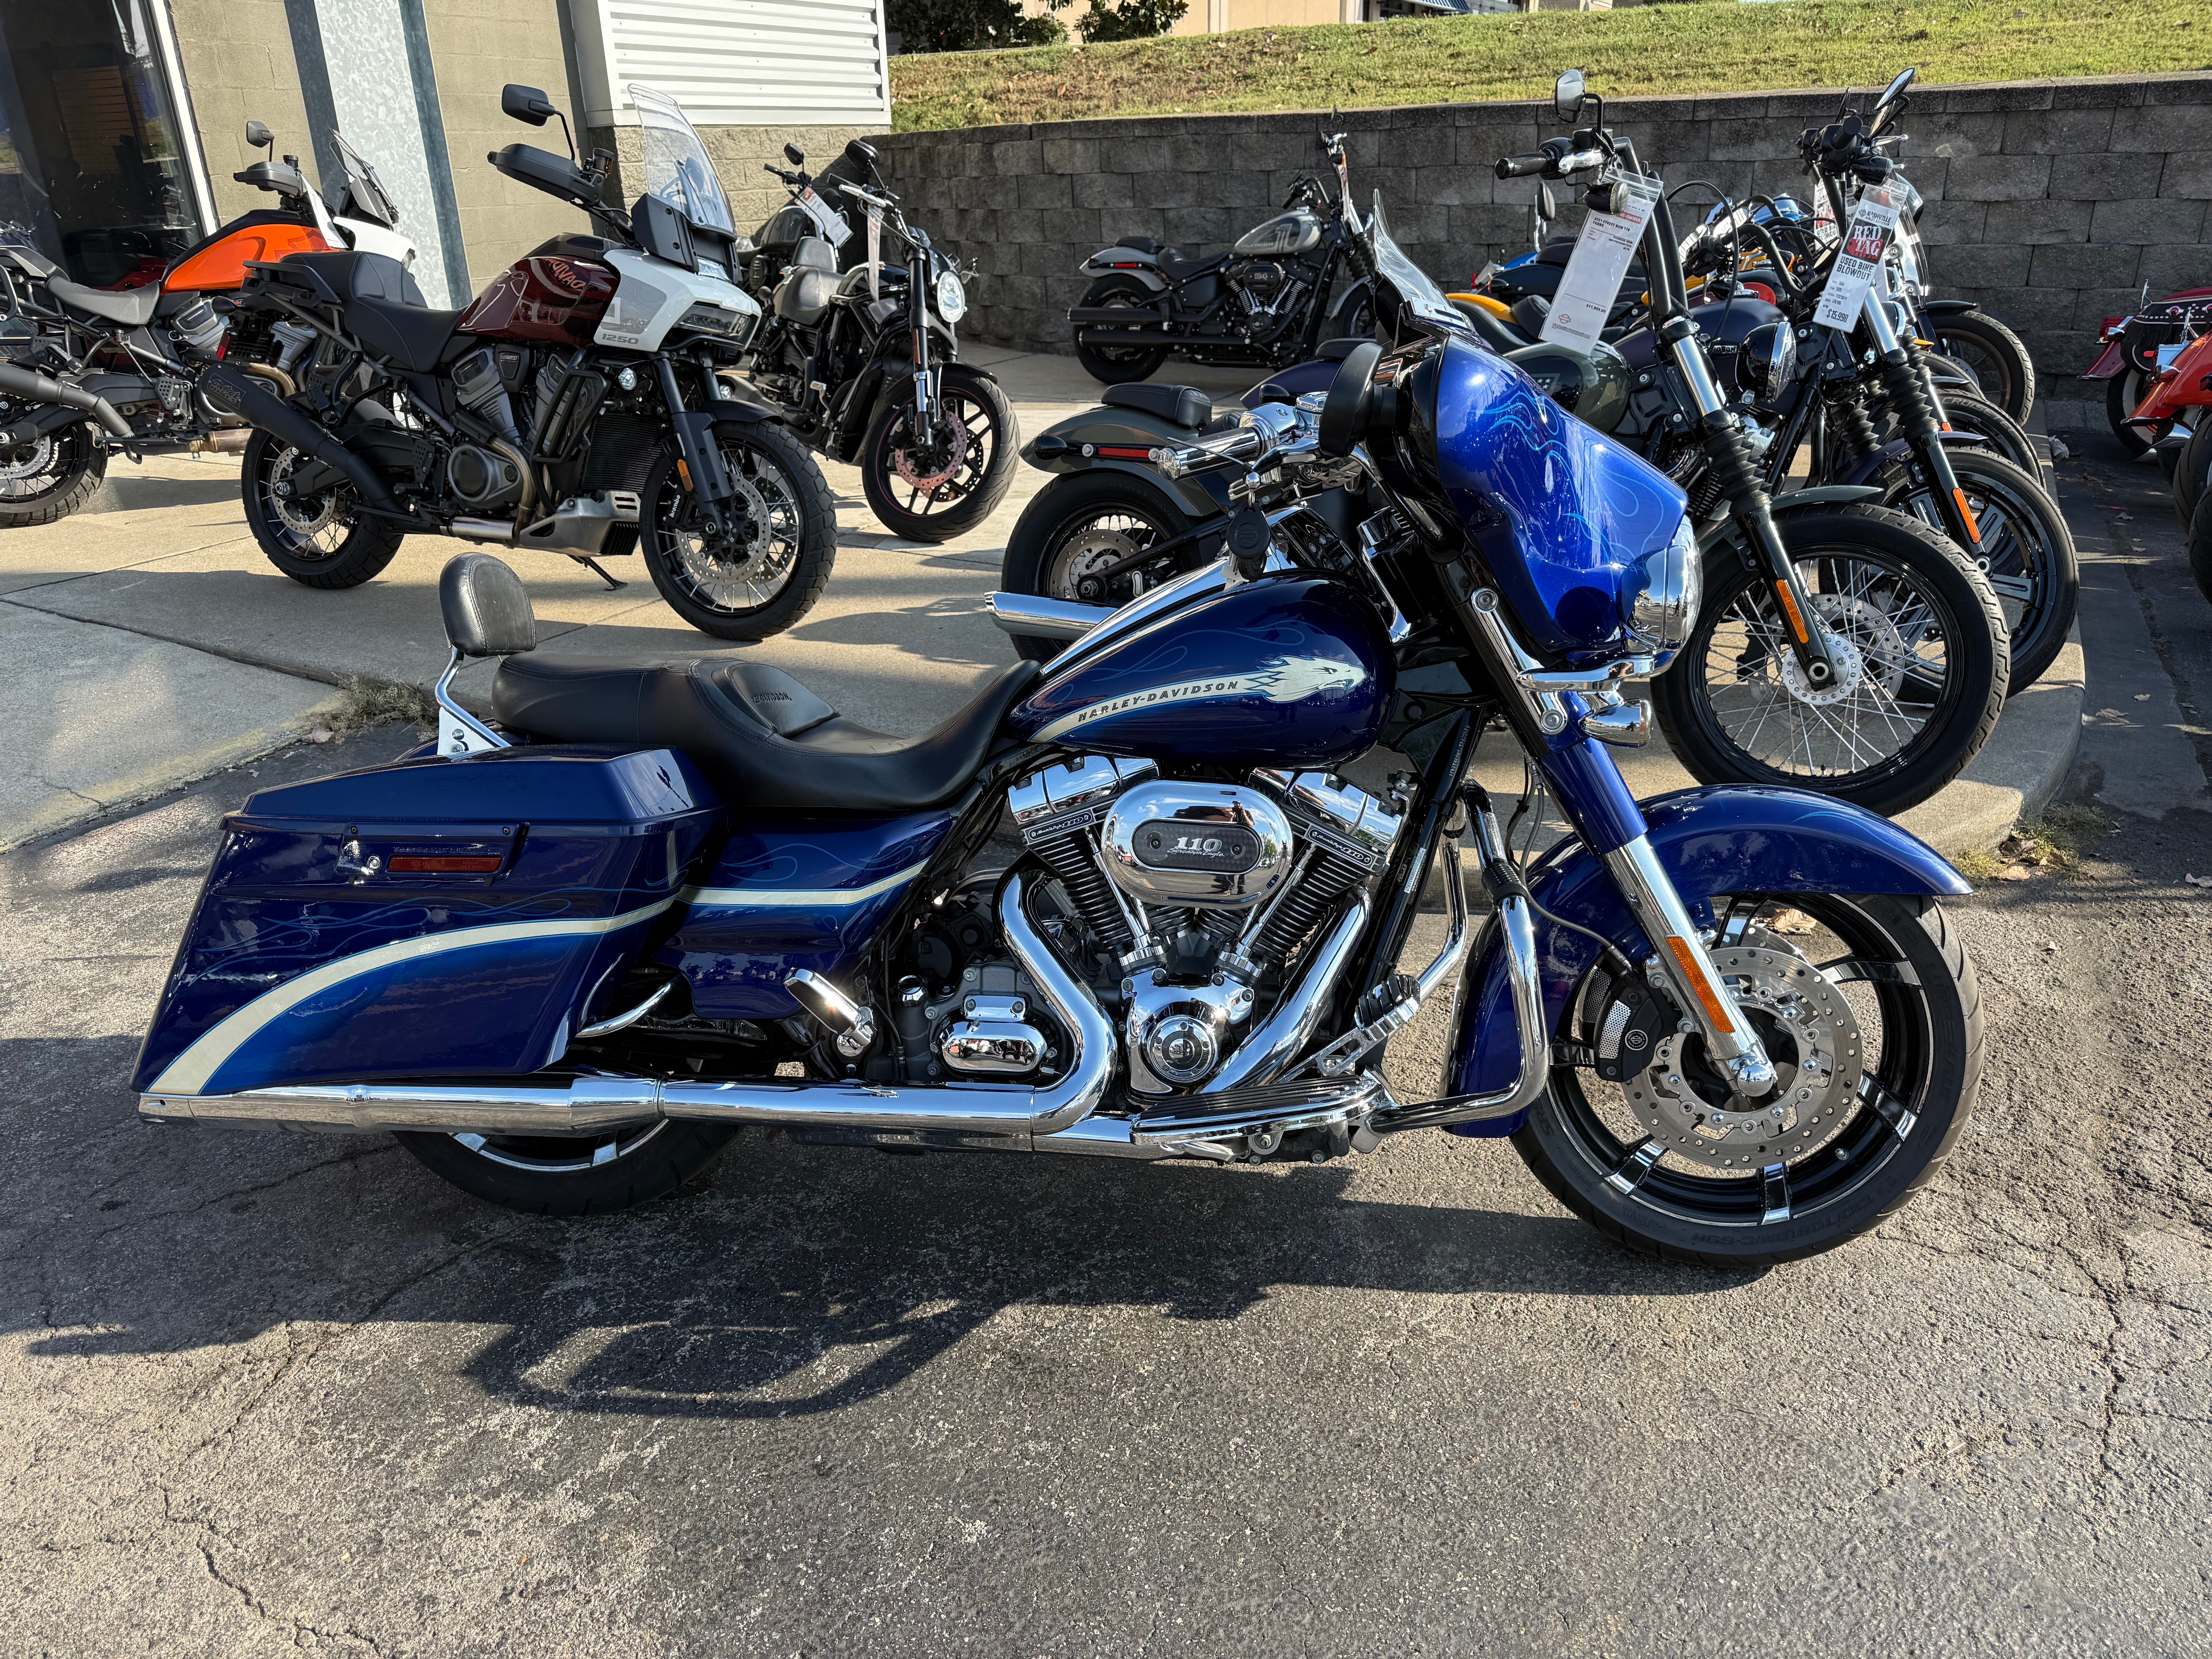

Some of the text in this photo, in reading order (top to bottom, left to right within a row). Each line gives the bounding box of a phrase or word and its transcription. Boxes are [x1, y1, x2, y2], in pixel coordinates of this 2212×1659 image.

[1619, 213, 1641, 222] RE-OWNED
[1867, 210, 1892, 223] NASHVILLE
[1853, 224, 1882, 240] RED
[1855, 237, 1881, 256] TAG
[1837, 264, 1871, 281] BLOWOUT
[1840, 256, 1874, 273] USED BIKE
[602, 333, 639, 344] 1250
[669, 495, 680, 518] brembo
[1110, 482, 1183, 532] HARLEY-DAVIDS
[1078, 681, 1238, 723] HARLEY-DAVIDSON
[1174, 837, 1222, 852] 110
